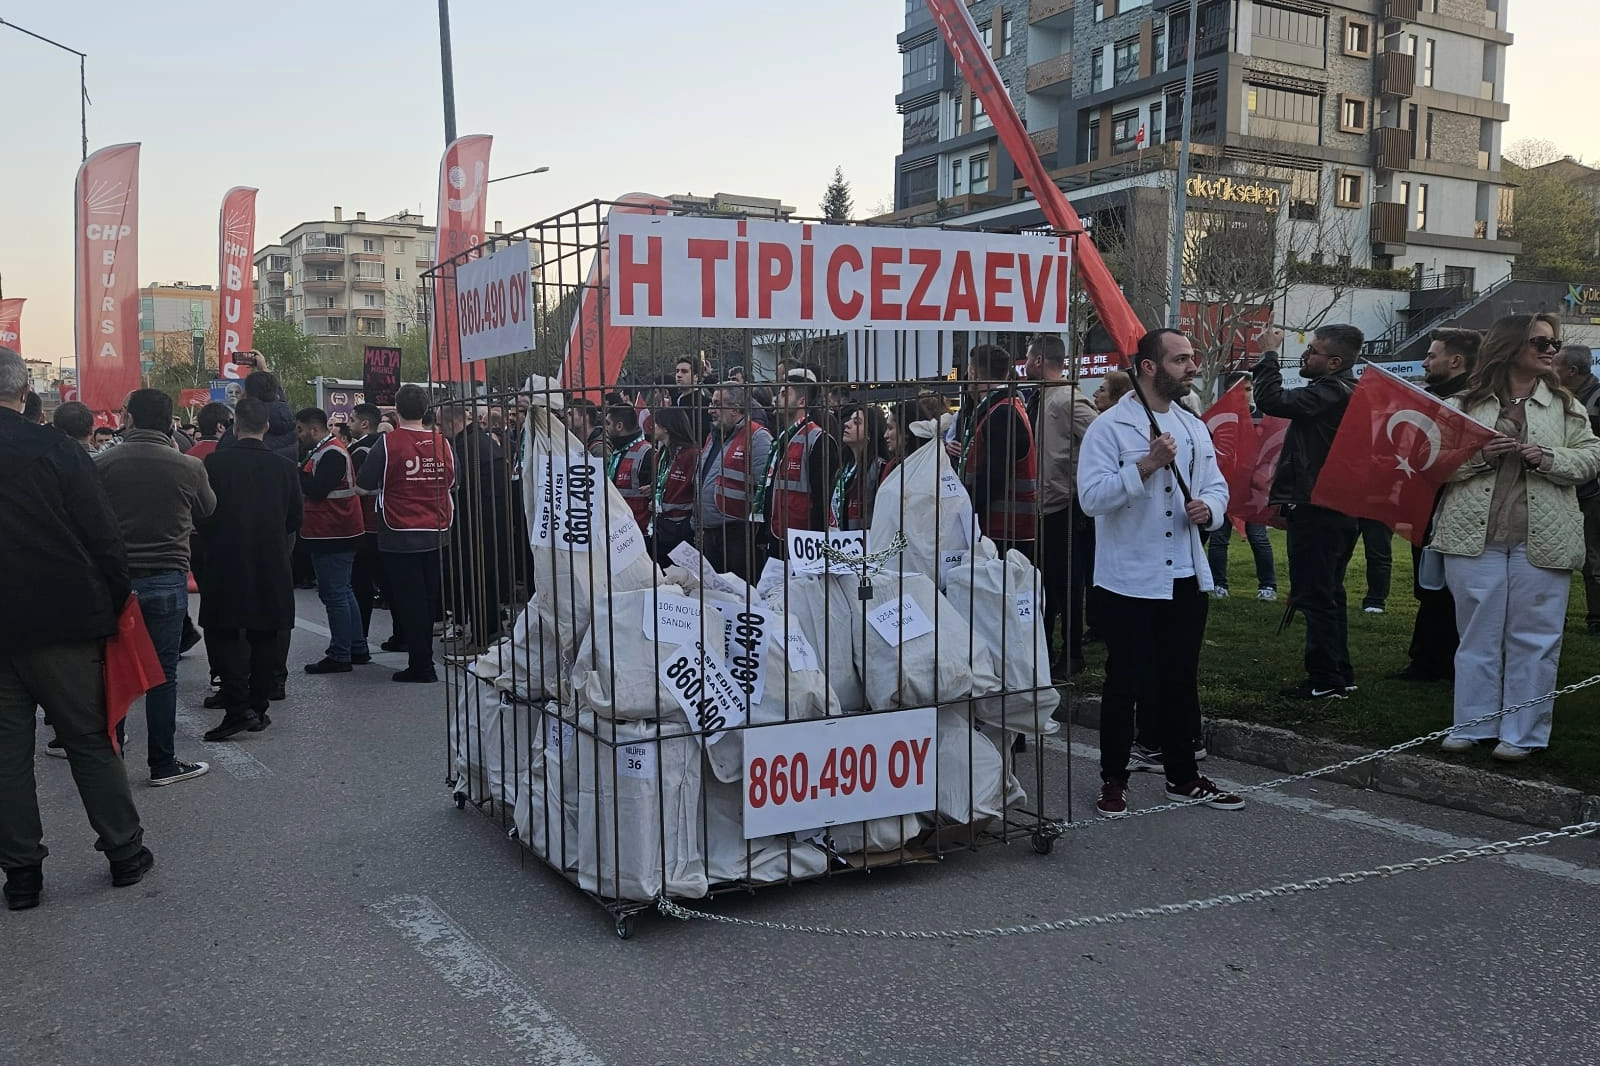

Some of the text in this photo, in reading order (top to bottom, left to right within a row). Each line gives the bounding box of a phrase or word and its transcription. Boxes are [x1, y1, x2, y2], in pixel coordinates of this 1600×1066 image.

[86, 224, 131, 241] CHP
[618, 234, 663, 317] H
[1583, 287, 1600, 304] yük
[100, 250, 118, 357] BURSA
[224, 263, 242, 379] BURS
[459, 281, 507, 337] 860.490
[509, 271, 527, 323] OY
[0, 330, 18, 342] HP
[365, 349, 400, 368] MAFYA
[540, 506, 550, 539] GASP
[553, 473, 564, 530] OY SAYISI
[563, 464, 596, 545] 860.490
[658, 602, 674, 612] 106
[661, 616, 692, 630] SANDIK
[666, 656, 727, 738] 860.490
[695, 641, 746, 713] GSP EDİLEN
[705, 674, 731, 710] SAYISI
[628, 758, 642, 770] 36
[748, 737, 931, 809] 860.490 OY
